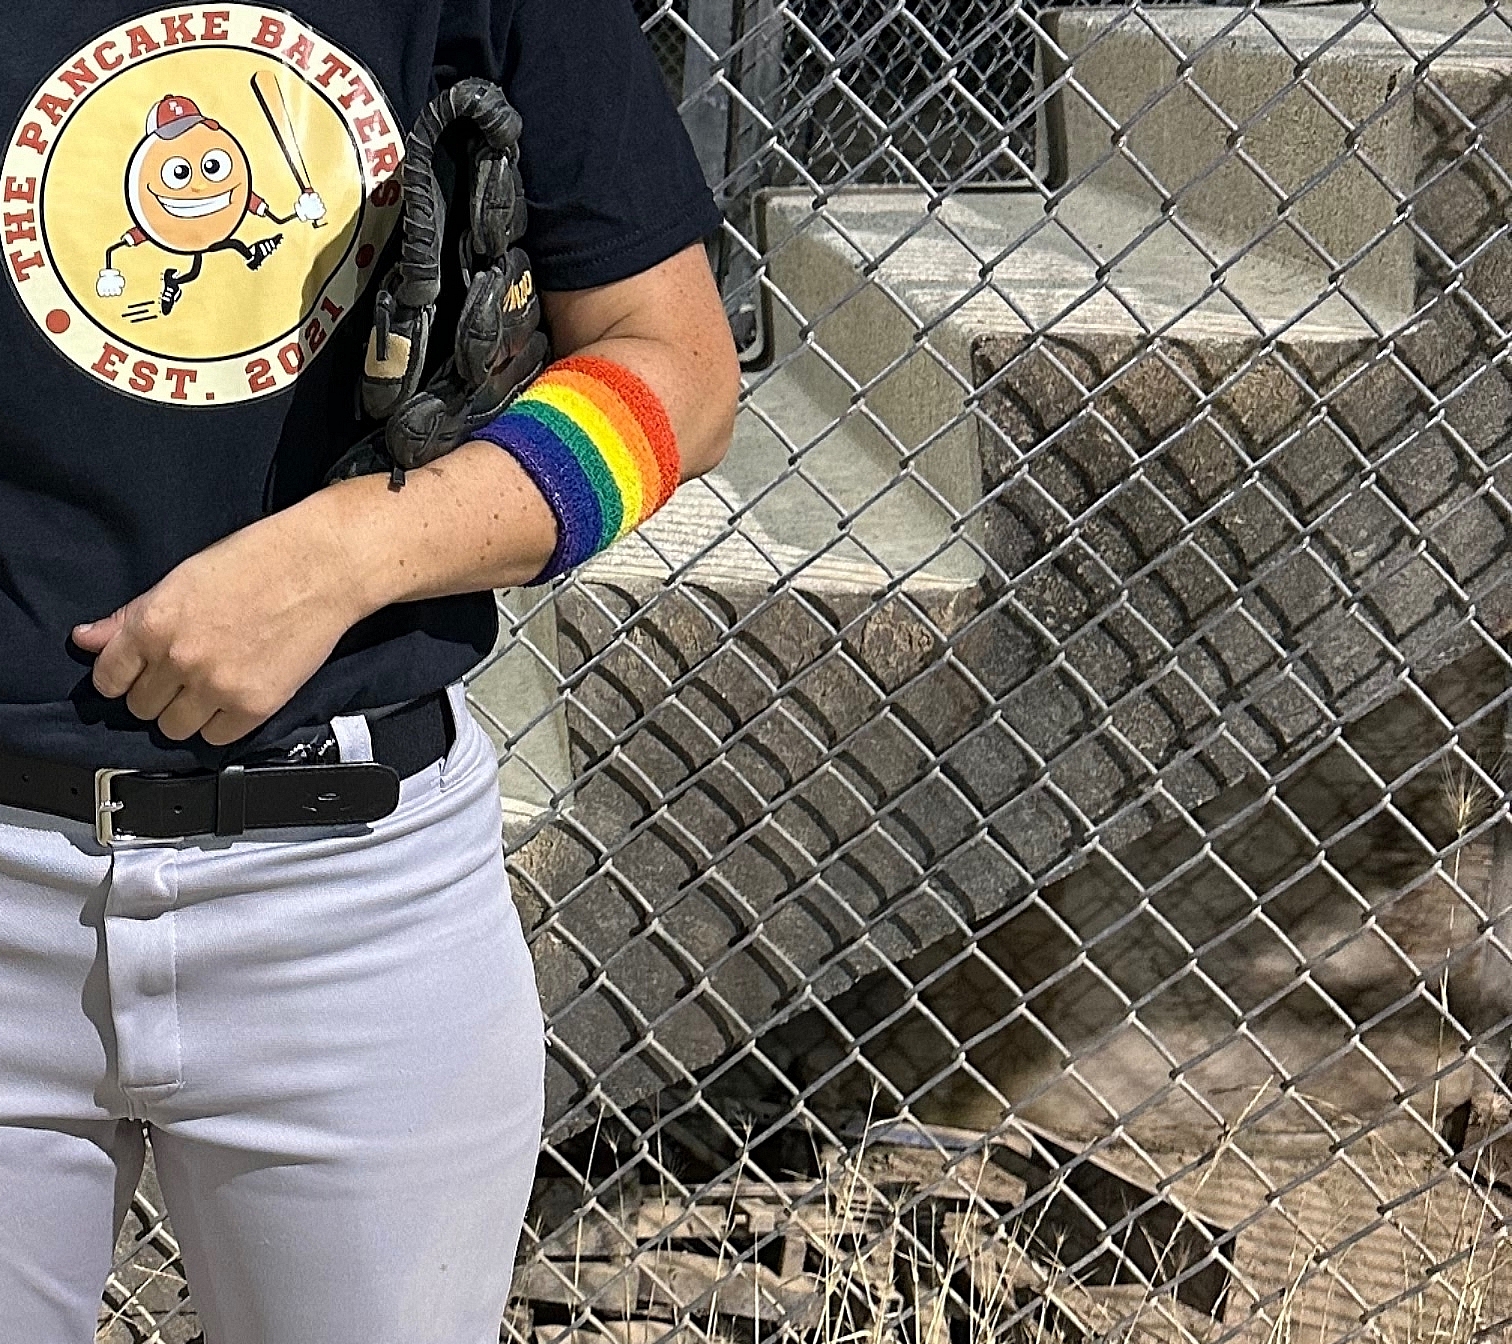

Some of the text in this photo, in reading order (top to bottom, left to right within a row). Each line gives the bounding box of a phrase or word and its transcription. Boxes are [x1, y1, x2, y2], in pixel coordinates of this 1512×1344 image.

[3, 10, 401, 282] THE PANCAKE BATTERS
[90, 296, 345, 401] EST. 2021
